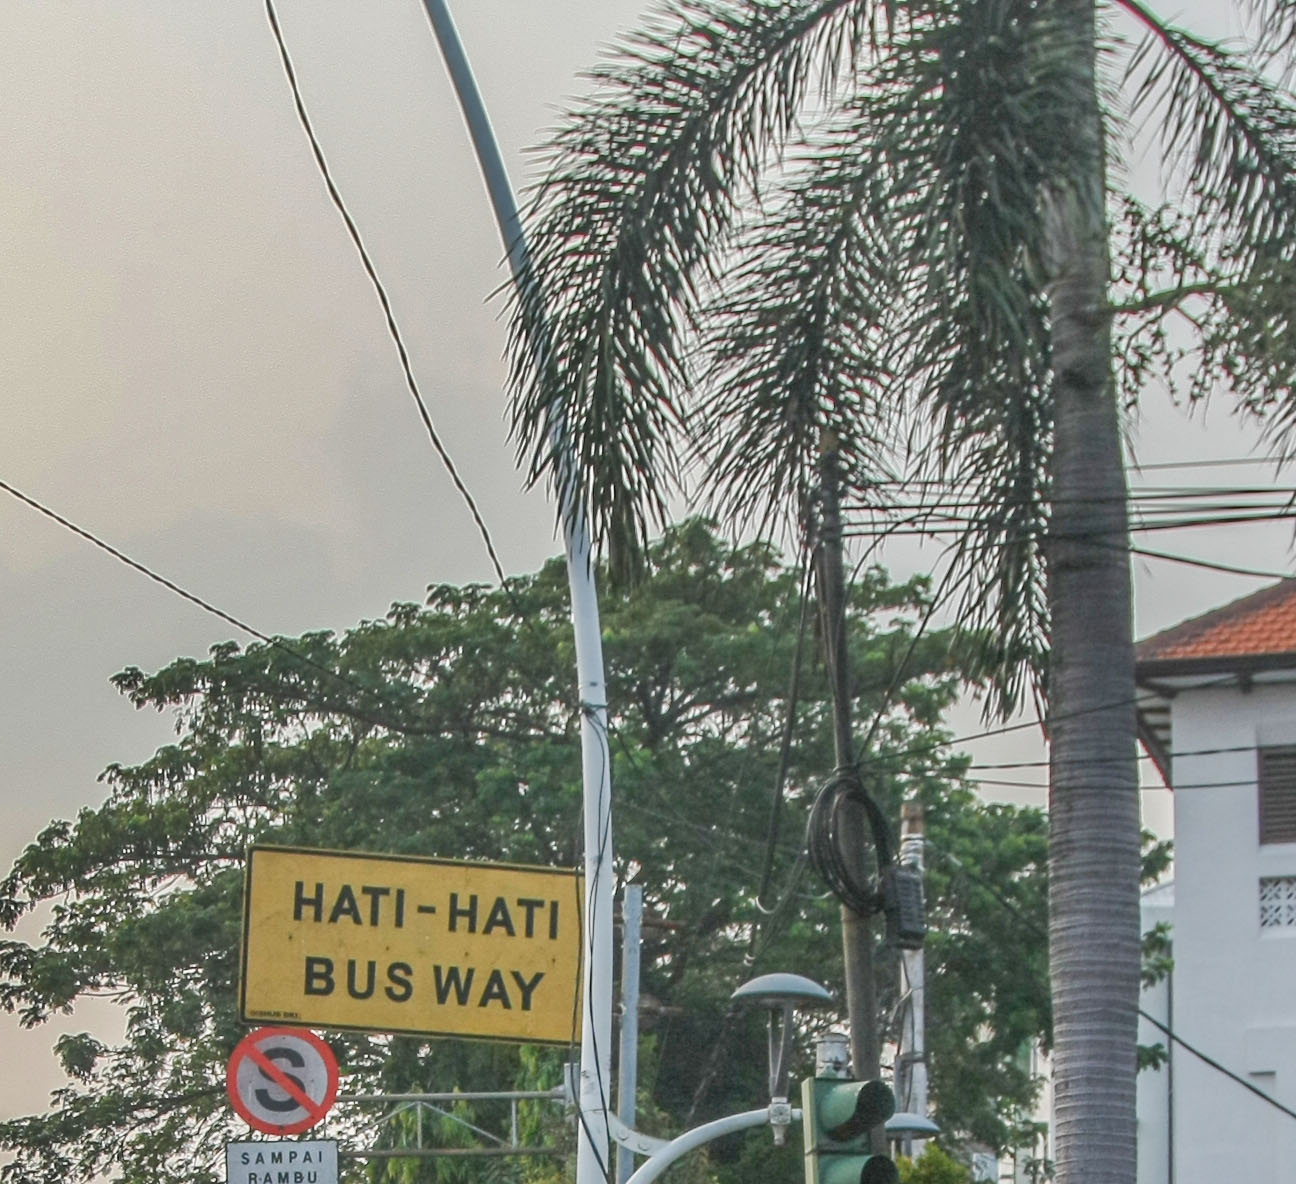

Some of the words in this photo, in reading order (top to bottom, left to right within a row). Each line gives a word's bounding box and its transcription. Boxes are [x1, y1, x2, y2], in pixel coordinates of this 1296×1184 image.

[293, 881, 559, 940] HATI-HATI
[304, 956, 413, 1003] BUS
[433, 965, 545, 1011] WAY
[255, 1047, 306, 1112] S
[241, 1151, 322, 1165] SAMPAI
[248, 1172, 317, 1184] RAMBU
